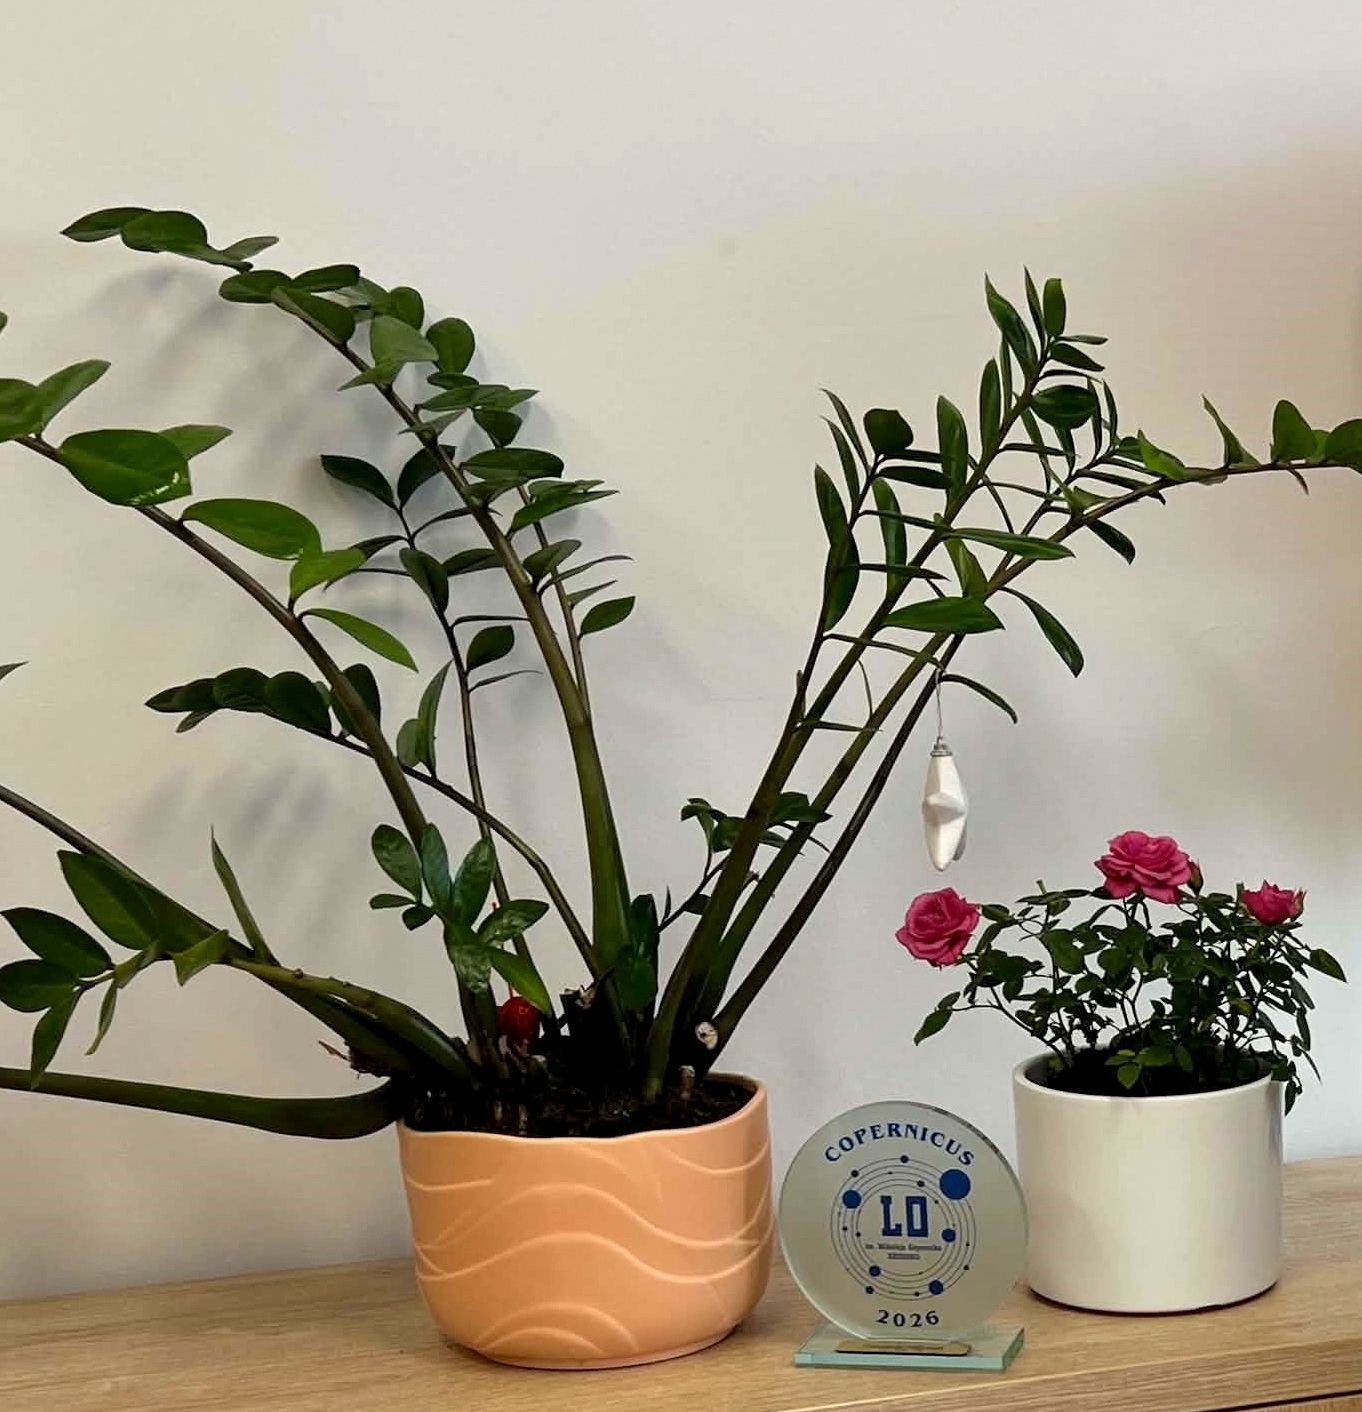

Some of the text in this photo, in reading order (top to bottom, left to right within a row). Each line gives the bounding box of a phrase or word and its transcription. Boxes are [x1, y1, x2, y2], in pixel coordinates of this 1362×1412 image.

[824, 1122, 975, 1166] COPERNICUS
[881, 1195, 929, 1238] LO
[876, 1309, 939, 1328] 2026
